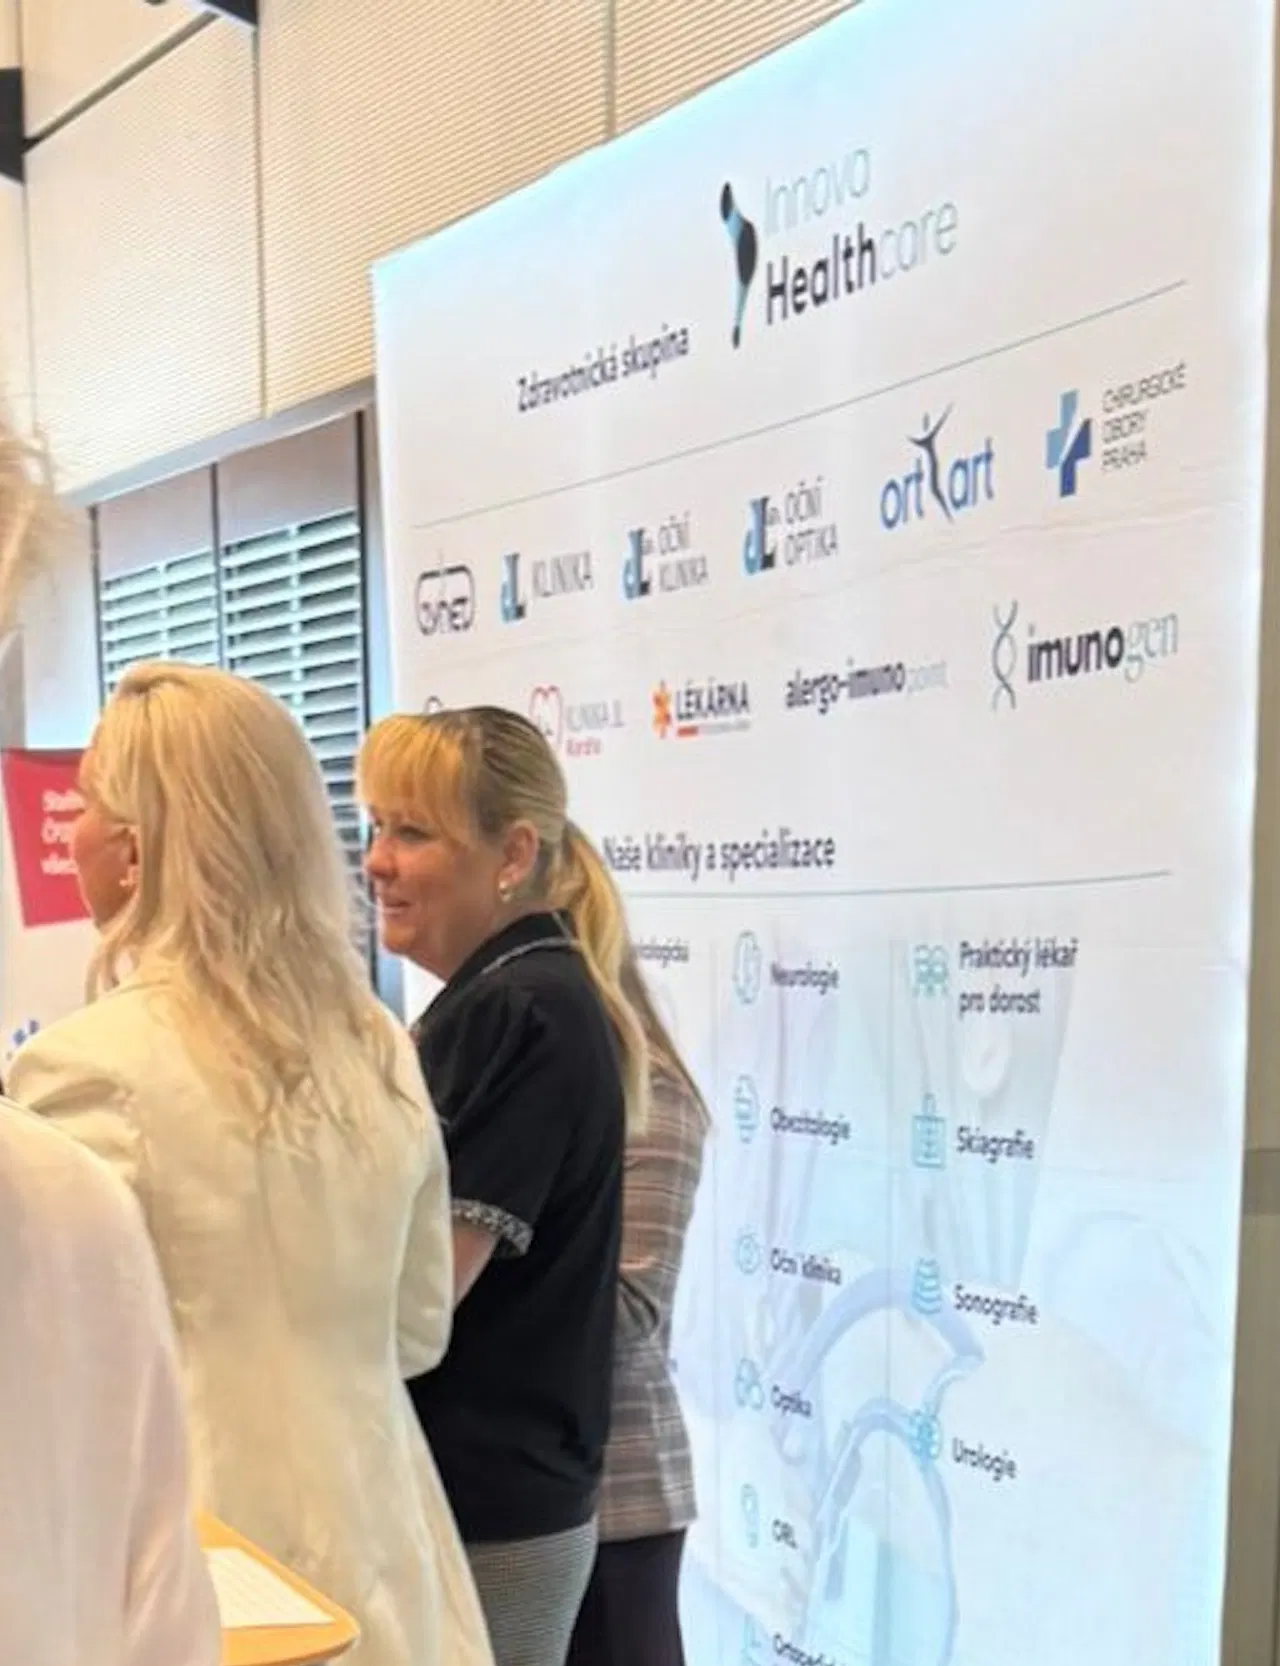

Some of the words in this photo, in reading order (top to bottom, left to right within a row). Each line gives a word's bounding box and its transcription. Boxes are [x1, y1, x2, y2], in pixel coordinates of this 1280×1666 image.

[767, 203, 959, 326] Healthcare
[518, 343, 618, 413] Zdravotnická
[622, 322, 689, 379] skupina
[1027, 613, 1179, 684] imunogen
[677, 677, 751, 720] LÉKÁRNA
[603, 835, 641, 872] Naše
[645, 831, 702, 882] kliniky
[706, 843, 716, 870] a
[720, 825, 836, 884] specializace
[771, 961, 839, 995] Neurologie
[959, 938, 1032, 979] Praktický
[1035, 936, 1079, 969] lékař
[959, 992, 985, 1020] pro
[989, 984, 1041, 1014] dorost
[956, 1125, 1035, 1164] Skiagrafie
[953, 1283, 1039, 1326] Sonografie
[952, 1437, 1018, 1482] Urologie
